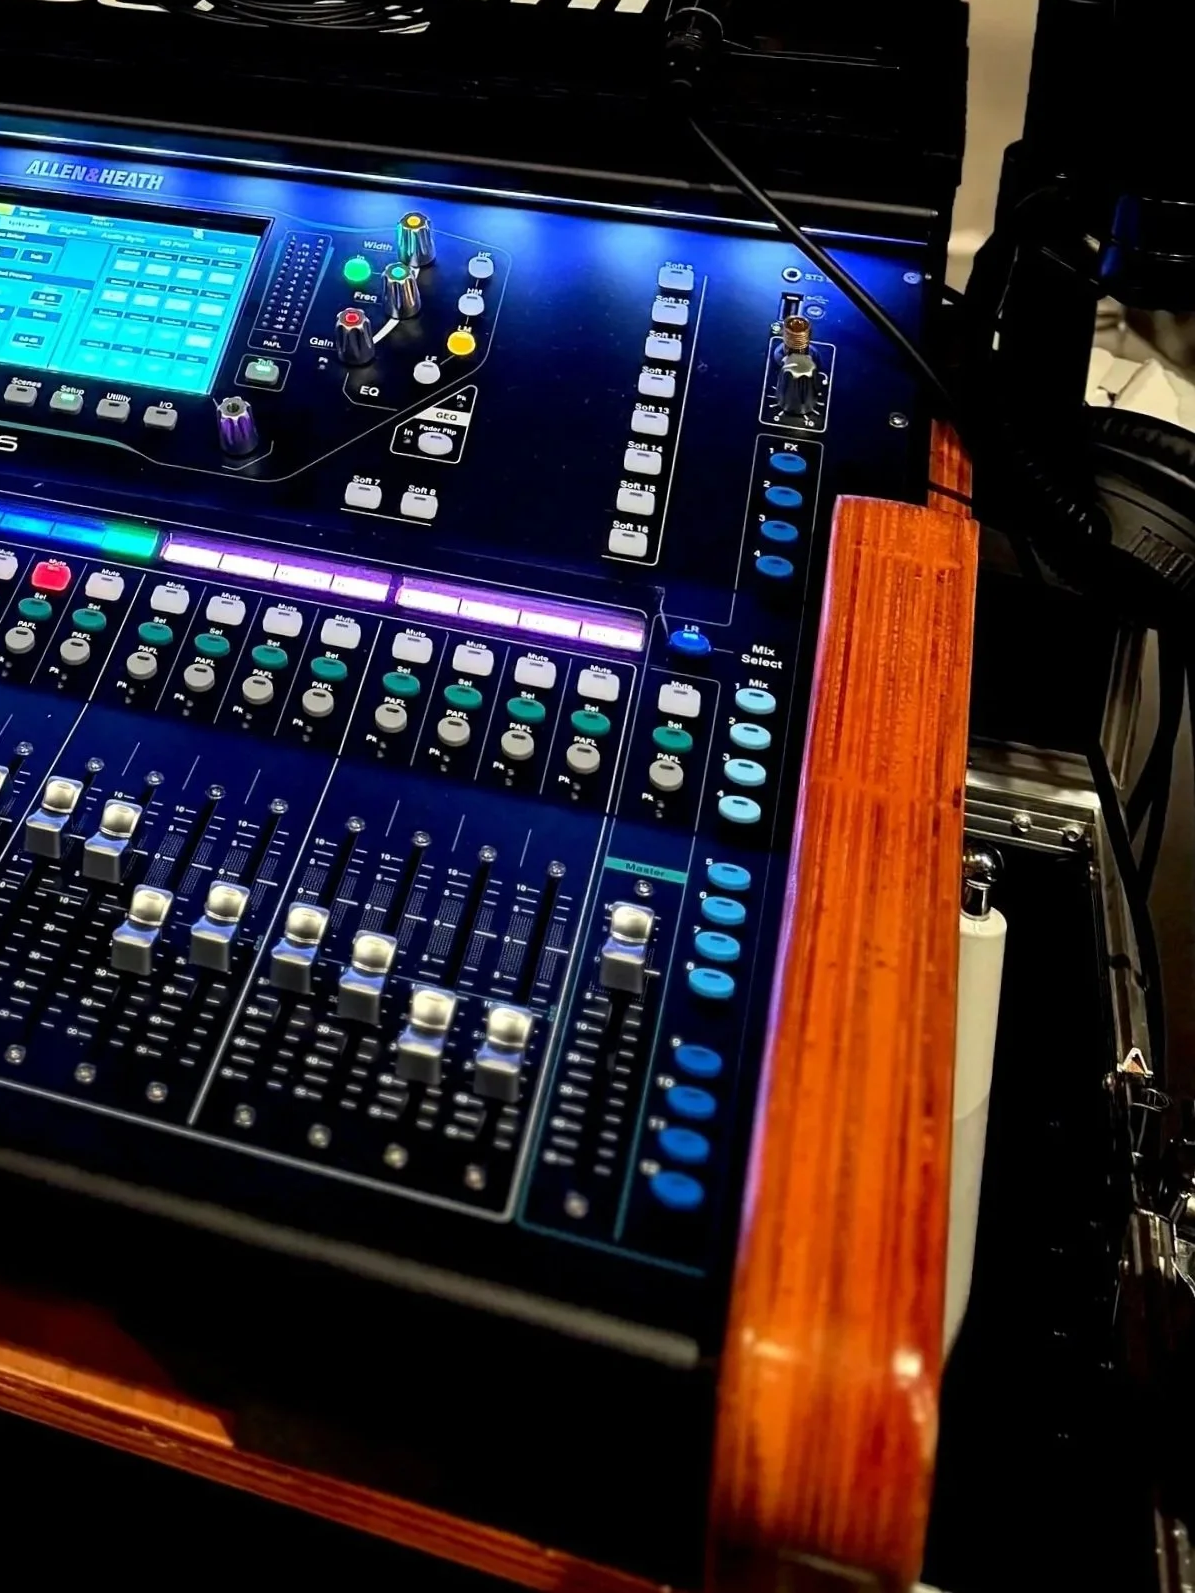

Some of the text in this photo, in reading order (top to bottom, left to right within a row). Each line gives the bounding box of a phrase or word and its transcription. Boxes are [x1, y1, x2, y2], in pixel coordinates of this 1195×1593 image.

[25, 159, 165, 191] ALLEN&HEATH
[363, 241, 393, 251] Width
[665, 261, 684, 269] Soft
[467, 287, 483, 295] HM
[354, 291, 378, 303] Freq
[655, 295, 675, 303] Soft
[457, 325, 472, 333] LM
[649, 330, 669, 339] Soft
[263, 340, 282, 348] PAFL
[309, 337, 334, 348] Gain
[642, 365, 677, 377] Soft 12
[11, 377, 43, 388] Scenes
[60, 384, 85, 396] Setup
[359, 385, 380, 397] EQ
[106, 392, 132, 404] Utility
[159, 401, 173, 410] I/O
[635, 402, 655, 412] Soft
[435, 411, 458, 422] GEQ
[403, 428, 413, 436] In
[419, 424, 457, 436] Fader Flip
[627, 440, 648, 450] Soft
[784, 442, 799, 451] FX
[353, 475, 372, 485] Soft
[763, 480, 771, 488] 2
[407, 484, 427, 494] Soft
[620, 480, 656, 492] Soft 15
[758, 514, 766, 522] 3
[612, 520, 649, 533] Soft 16
[102, 568, 121, 578] Mute
[221, 592, 241, 602] Mute
[87, 603, 101, 611] Sel
[209, 627, 223, 636] Sel
[406, 628, 426, 638] Mute
[684, 624, 700, 633] LR
[71, 631, 92, 641] PAFL
[466, 640, 487, 650] Mute
[751, 644, 775, 656] Mix
[194, 656, 216, 667] PAFL
[527, 652, 549, 662] Mute
[741, 654, 783, 669] Select
[396, 665, 411, 675] Sel
[590, 664, 612, 674] Mute
[457, 678, 473, 687] Sel
[671, 680, 694, 690] Mute
[748, 678, 769, 689] Mix
[520, 691, 535, 700] Sel
[384, 696, 406, 707] PAFL
[584, 704, 599, 712] Sel
[446, 709, 469, 720] PAFL
[667, 720, 683, 730] Sel
[728, 716, 736, 724] 2
[509, 722, 532, 733] PAFL
[366, 734, 377, 742] Pk
[573, 735, 597, 746] PAFL
[428, 747, 440, 756] Pk
[657, 752, 681, 764] PAFL
[722, 753, 730, 761] 3
[493, 761, 505, 770] Pk
[558, 775, 571, 784] Pk
[641, 792, 654, 802] Pk
[716, 789, 724, 798] 4
[625, 862, 665, 878] Master
[699, 891, 707, 899] 6
[693, 926, 702, 934] 7
[686, 962, 695, 971] 8
[576, 1022, 588, 1031] 10
[672, 1037, 681, 1047] 9
[568, 1053, 581, 1062] 20
[658, 1077, 674, 1087] 10
[560, 1085, 573, 1093] 30
